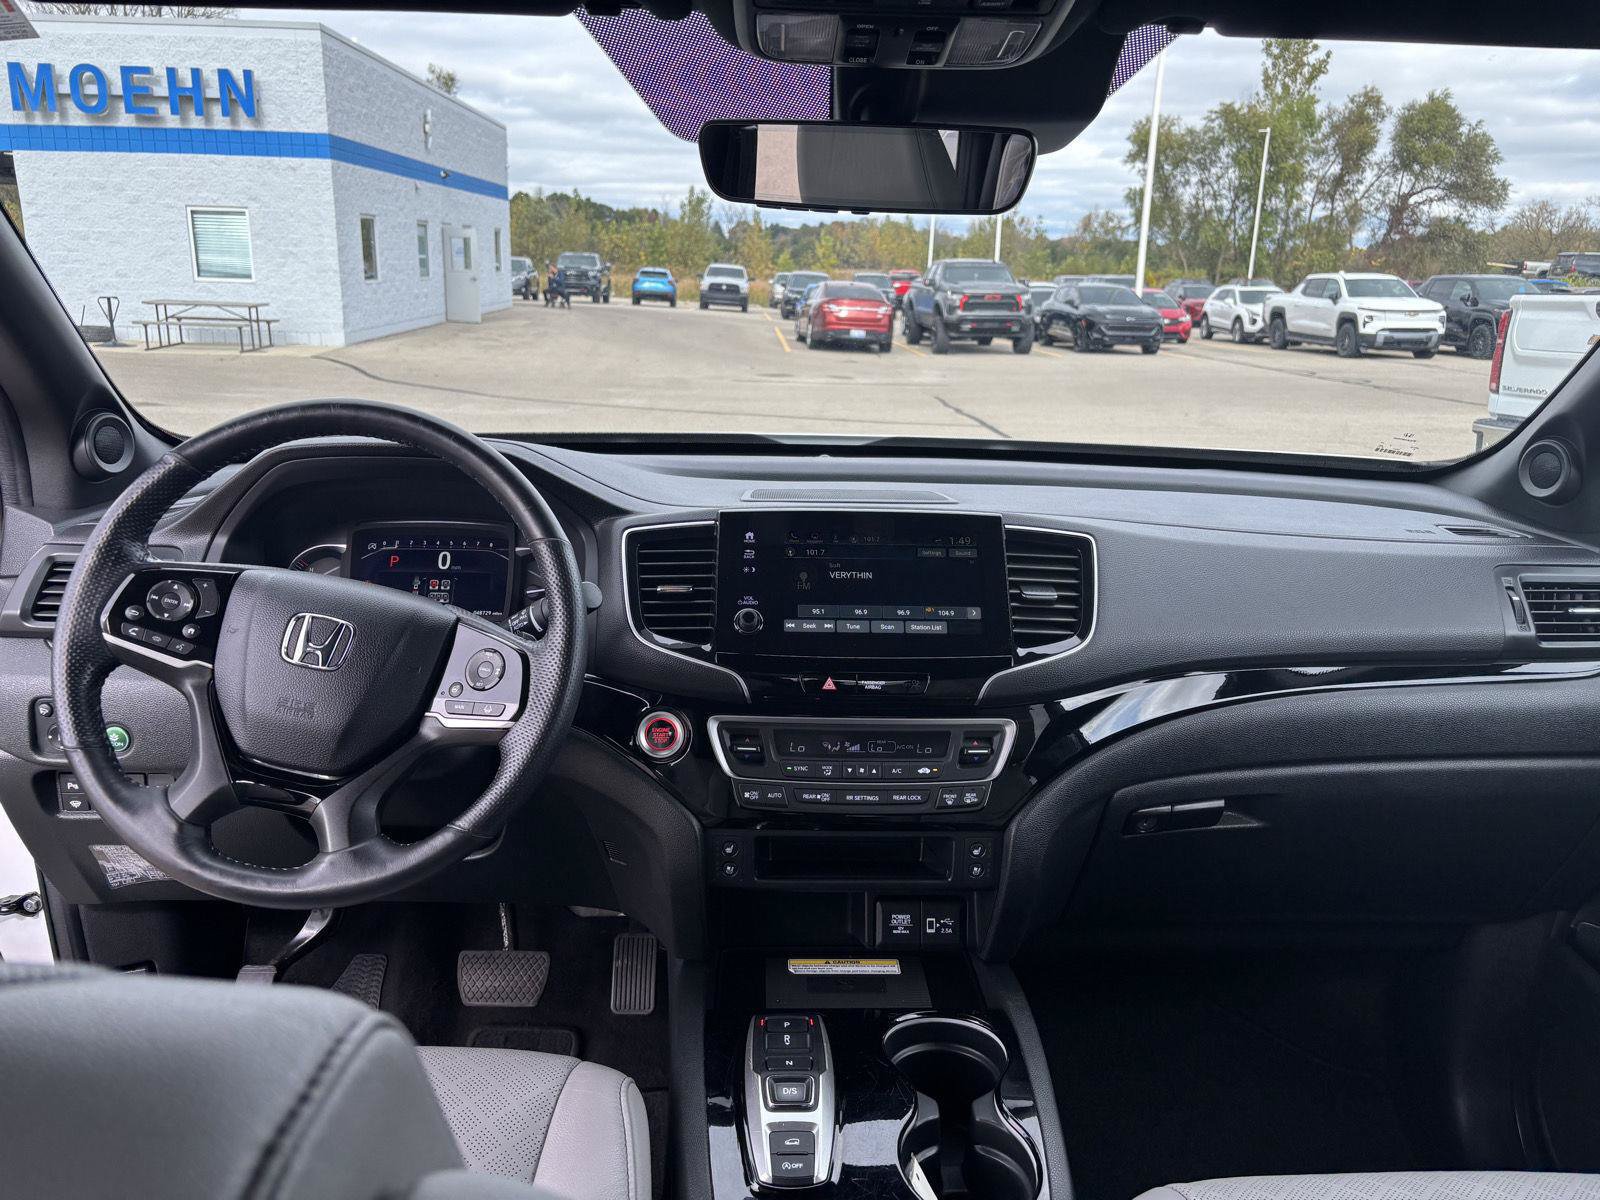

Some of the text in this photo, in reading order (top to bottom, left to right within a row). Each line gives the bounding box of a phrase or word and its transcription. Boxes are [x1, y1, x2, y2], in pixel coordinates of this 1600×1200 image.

[7, 61, 257, 118] MOEHN
[949, 536, 972, 545] 1:49
[389, 555, 401, 568] P
[437, 551, 451, 570] 0
[829, 571, 873, 579] VERYTHIN
[163, 597, 179, 605] ENTER
[783, 1034, 791, 1042] R
[782, 1087, 798, 1095] D/S
